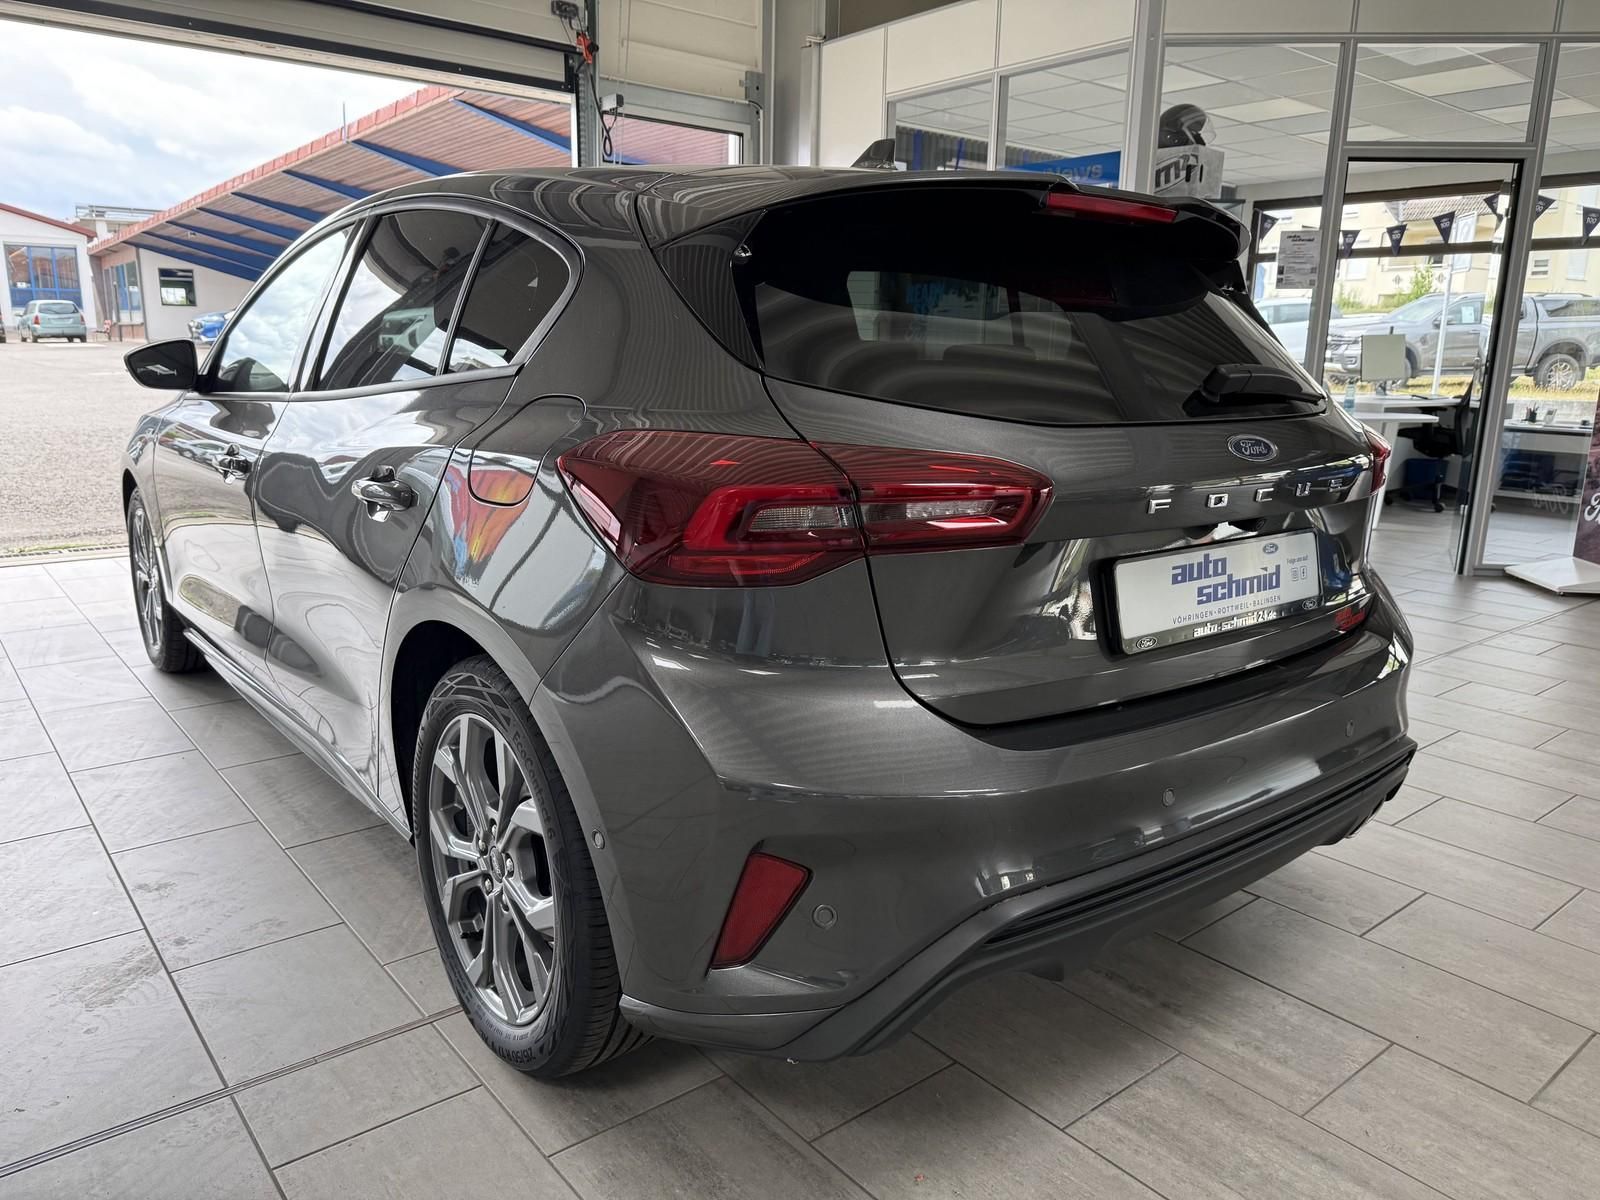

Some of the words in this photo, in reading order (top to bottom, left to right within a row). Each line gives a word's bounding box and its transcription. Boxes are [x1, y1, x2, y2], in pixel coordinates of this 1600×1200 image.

[1239, 439, 1269, 456] Ford
[1147, 478, 1342, 515] FOCUS
[1171, 553, 1228, 585] auto
[1197, 564, 1281, 606] schmid
[1217, 601, 1249, 615] ROTTWEIL
